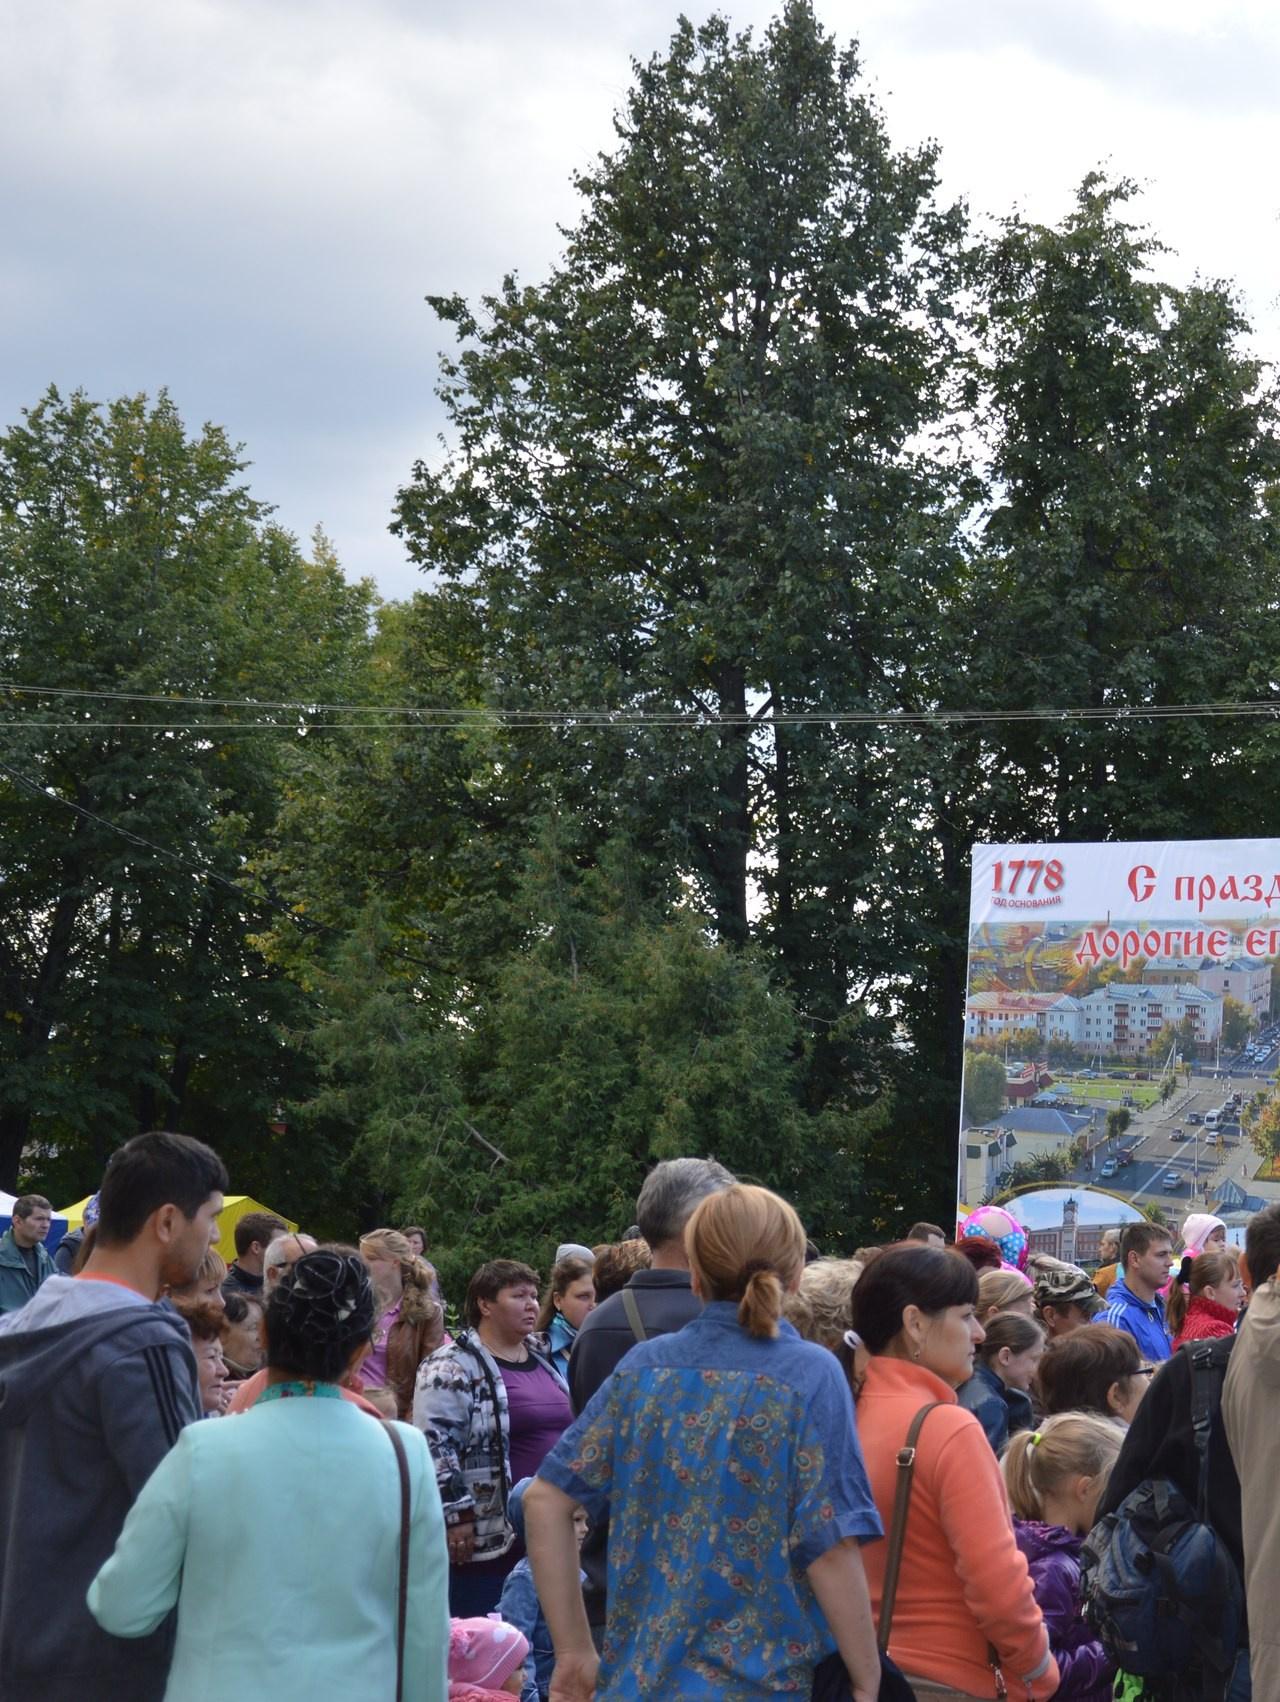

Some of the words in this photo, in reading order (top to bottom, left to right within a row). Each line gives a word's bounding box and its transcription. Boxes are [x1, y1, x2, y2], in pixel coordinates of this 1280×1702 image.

[992, 859, 1063, 894] 1778
[1127, 865, 1156, 902] С
[1008, 895, 1061, 909] ОСНОВАНИЯ
[1076, 930, 1228, 968] дорогие
